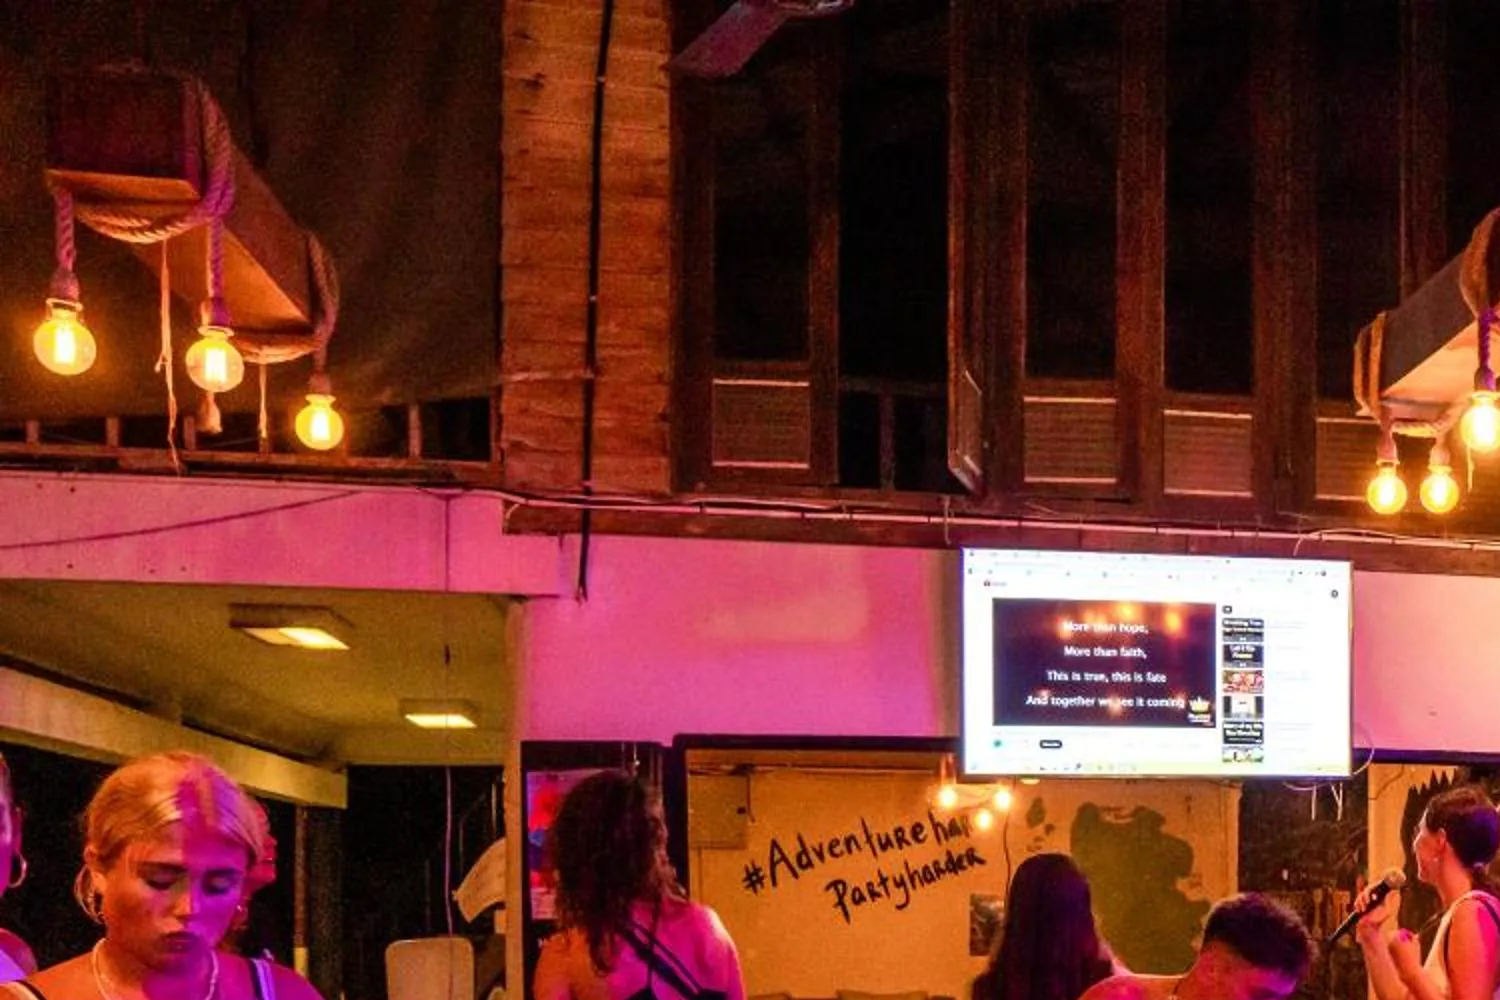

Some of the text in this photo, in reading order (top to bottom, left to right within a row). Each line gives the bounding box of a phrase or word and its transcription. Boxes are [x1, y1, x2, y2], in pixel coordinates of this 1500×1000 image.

[1063, 621, 1089, 632] More
[1064, 646, 1148, 659] More than faith,
[1046, 669, 1168, 683] This is true, this is fate
[1025, 694, 1049, 706] And
[1051, 695, 1096, 708] together
[1136, 696, 1145, 707] it
[1147, 697, 1186, 709] coming
